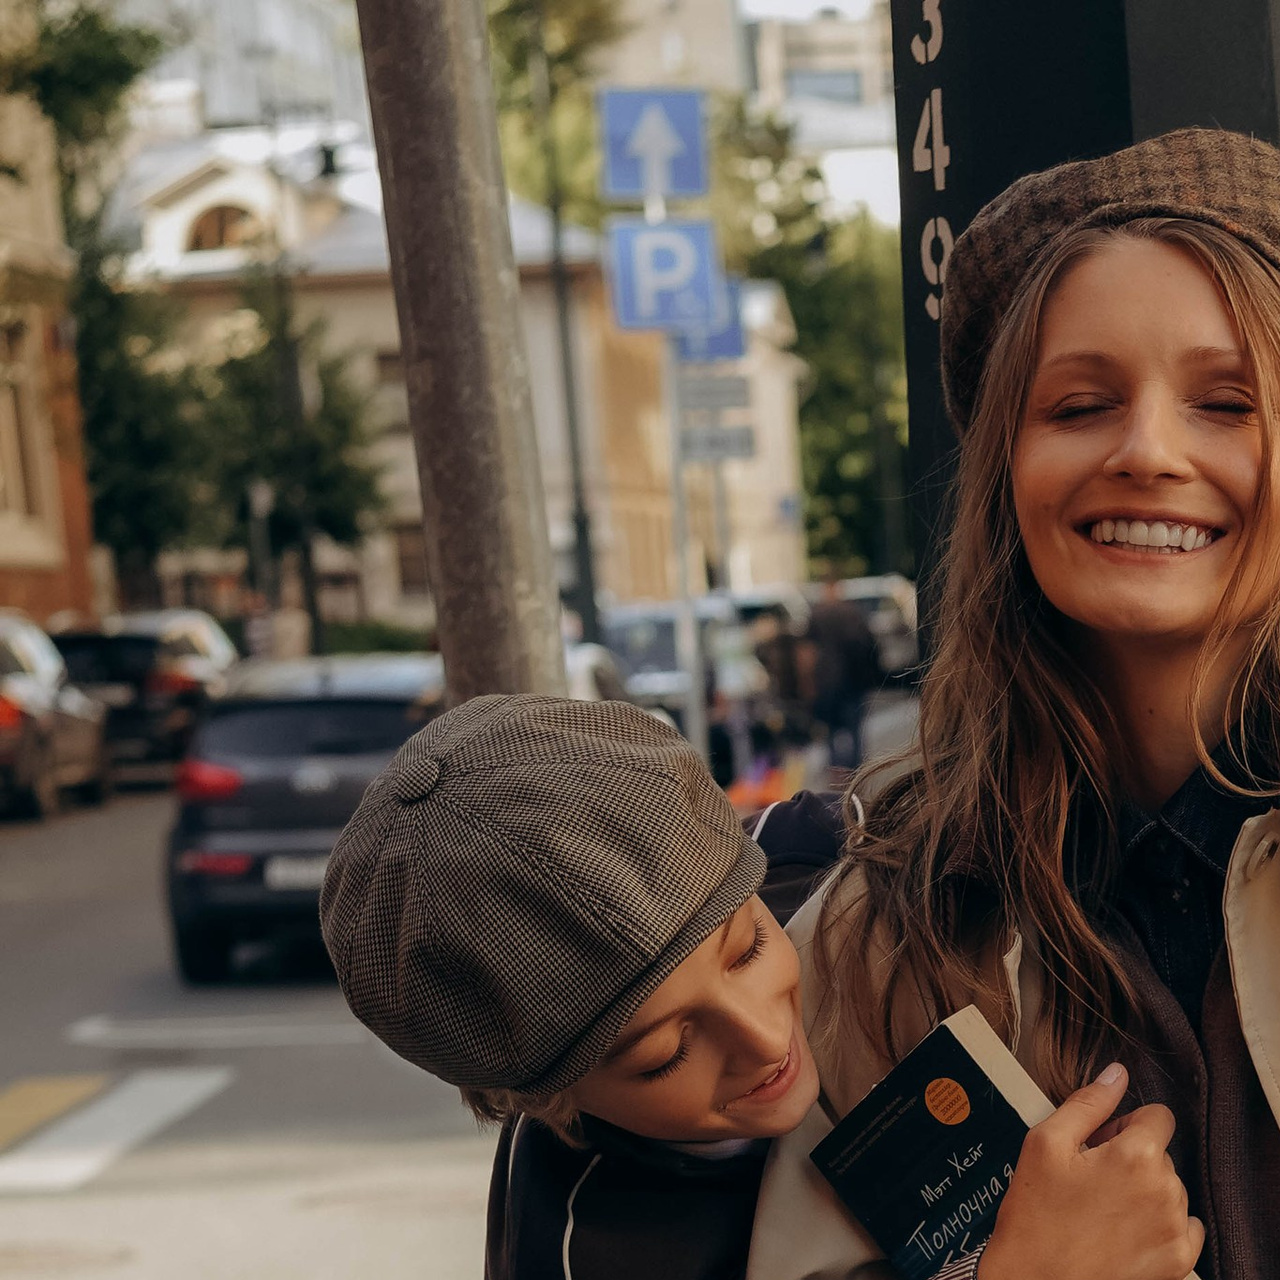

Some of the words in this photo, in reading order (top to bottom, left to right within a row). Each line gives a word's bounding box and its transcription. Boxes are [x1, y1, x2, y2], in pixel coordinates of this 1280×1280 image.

[633, 231, 697, 317] P
[905, 1163, 1015, 1261] Полночная
[920, 1176, 953, 1208] Мэтт
[946, 1142, 984, 1179] Хейг
